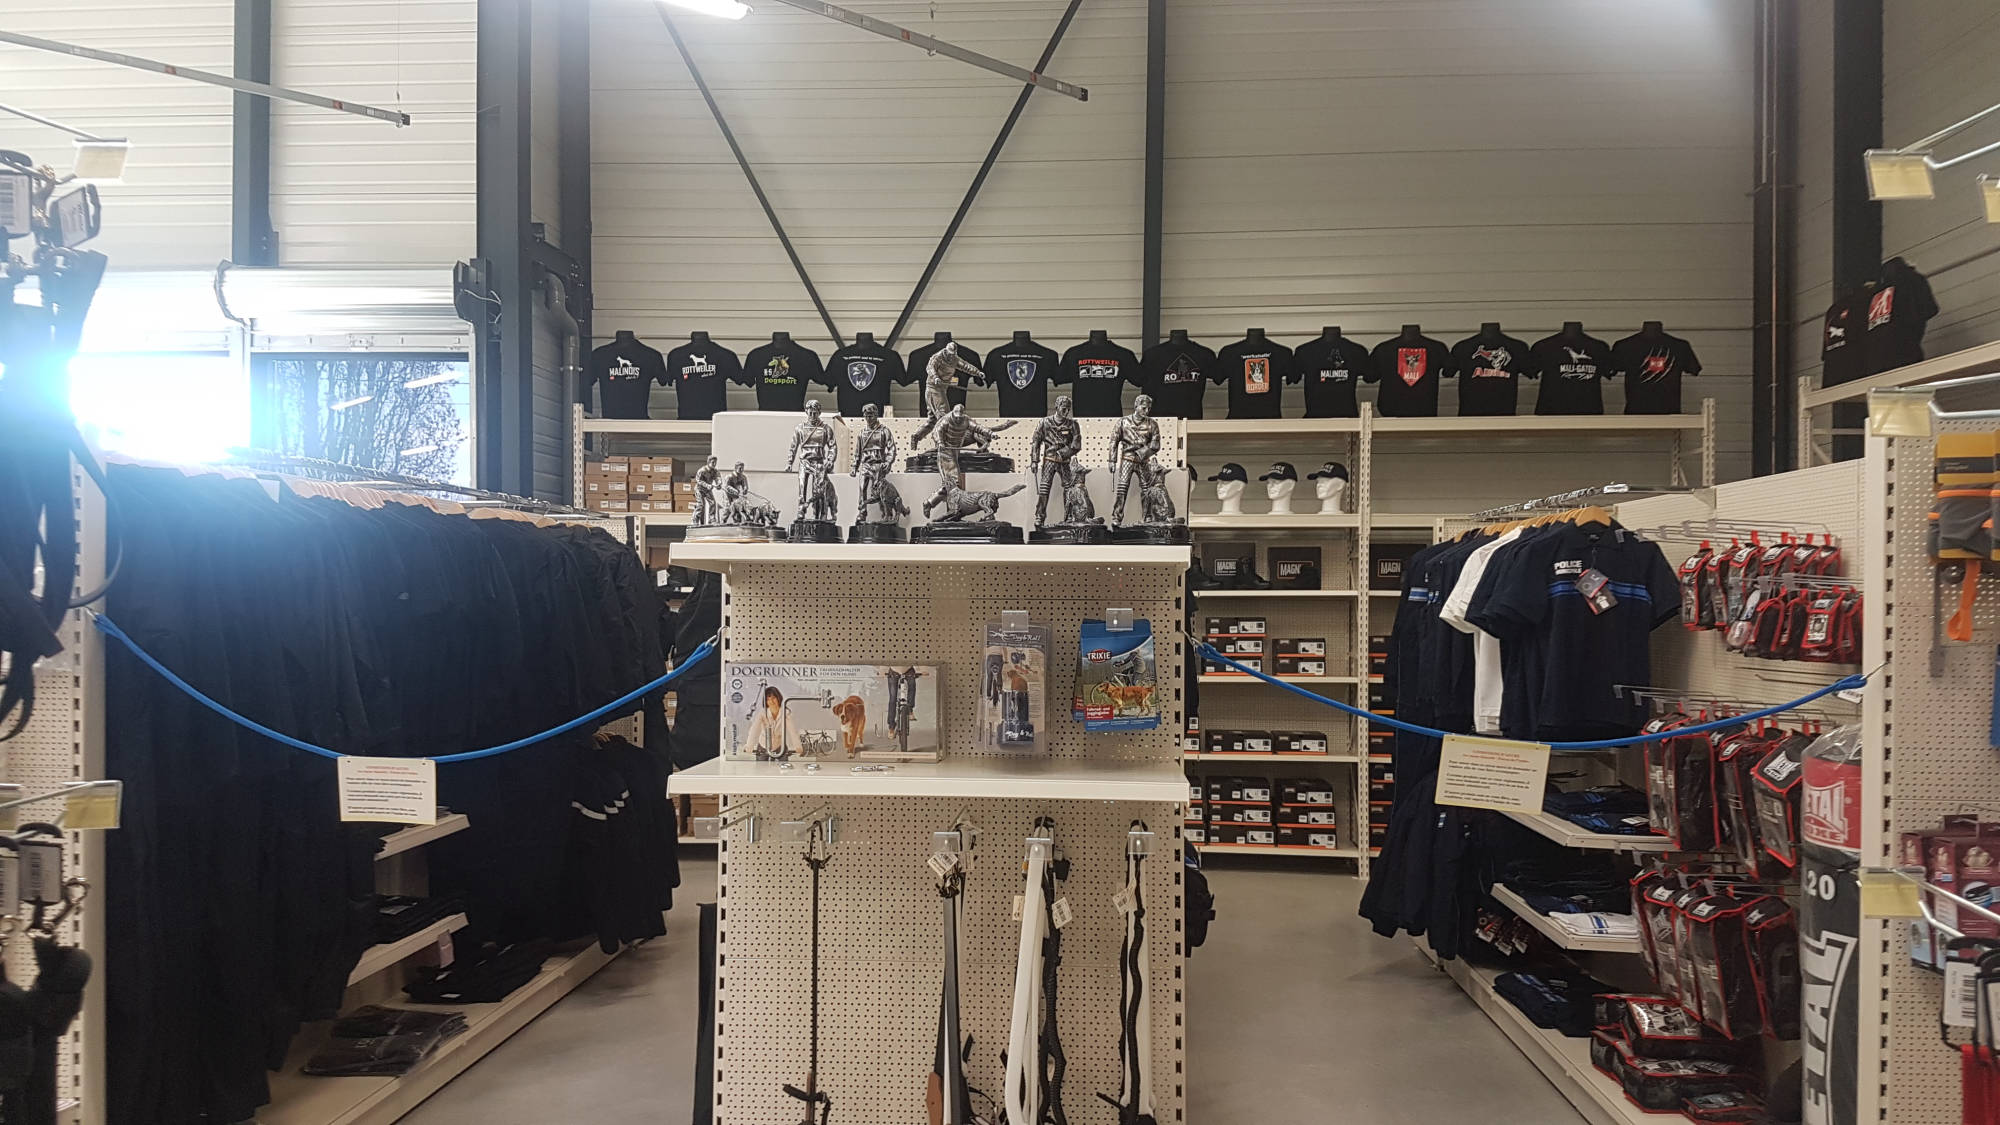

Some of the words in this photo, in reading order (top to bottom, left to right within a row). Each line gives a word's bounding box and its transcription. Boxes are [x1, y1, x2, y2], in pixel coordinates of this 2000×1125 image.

[609, 366, 640, 376] MALINOIS
[682, 365, 716, 375] ROTTWEILER
[1320, 370, 1349, 378] MALINOIS
[1280, 563, 1302, 576] MAGN
[1554, 560, 1583, 570] POLICE
[1087, 652, 1111, 660] TRIXIE
[731, 666, 818, 677] DOGRUNNER
[1805, 785, 1844, 834] ETAL
[1804, 824, 1842, 843] OXE
[1803, 944, 1842, 1125] ETAL
